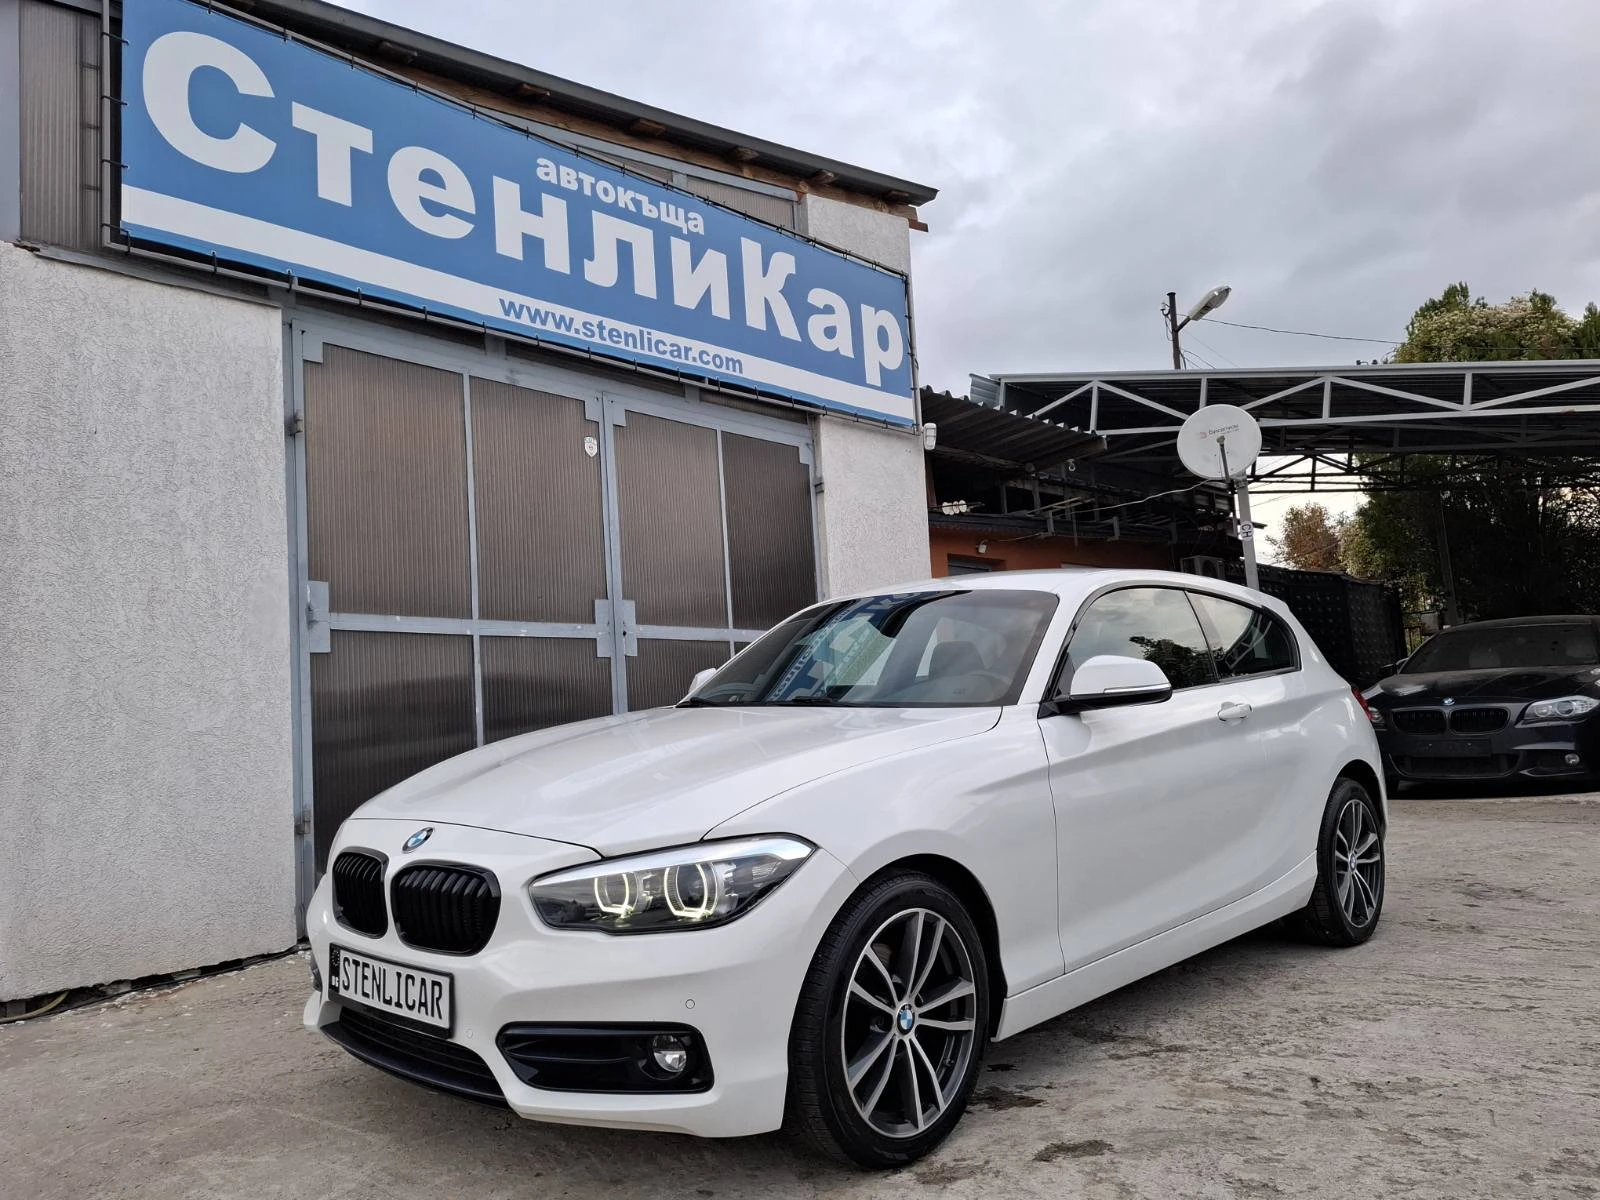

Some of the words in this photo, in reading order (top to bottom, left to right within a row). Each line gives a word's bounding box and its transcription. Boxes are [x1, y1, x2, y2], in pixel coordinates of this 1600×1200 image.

[142, 31, 904, 387] СтенлиКар
[536, 157, 705, 235] автокъща
[499, 298, 744, 375] www.stenlicar.com
[341, 956, 443, 1020] STENLICAR
